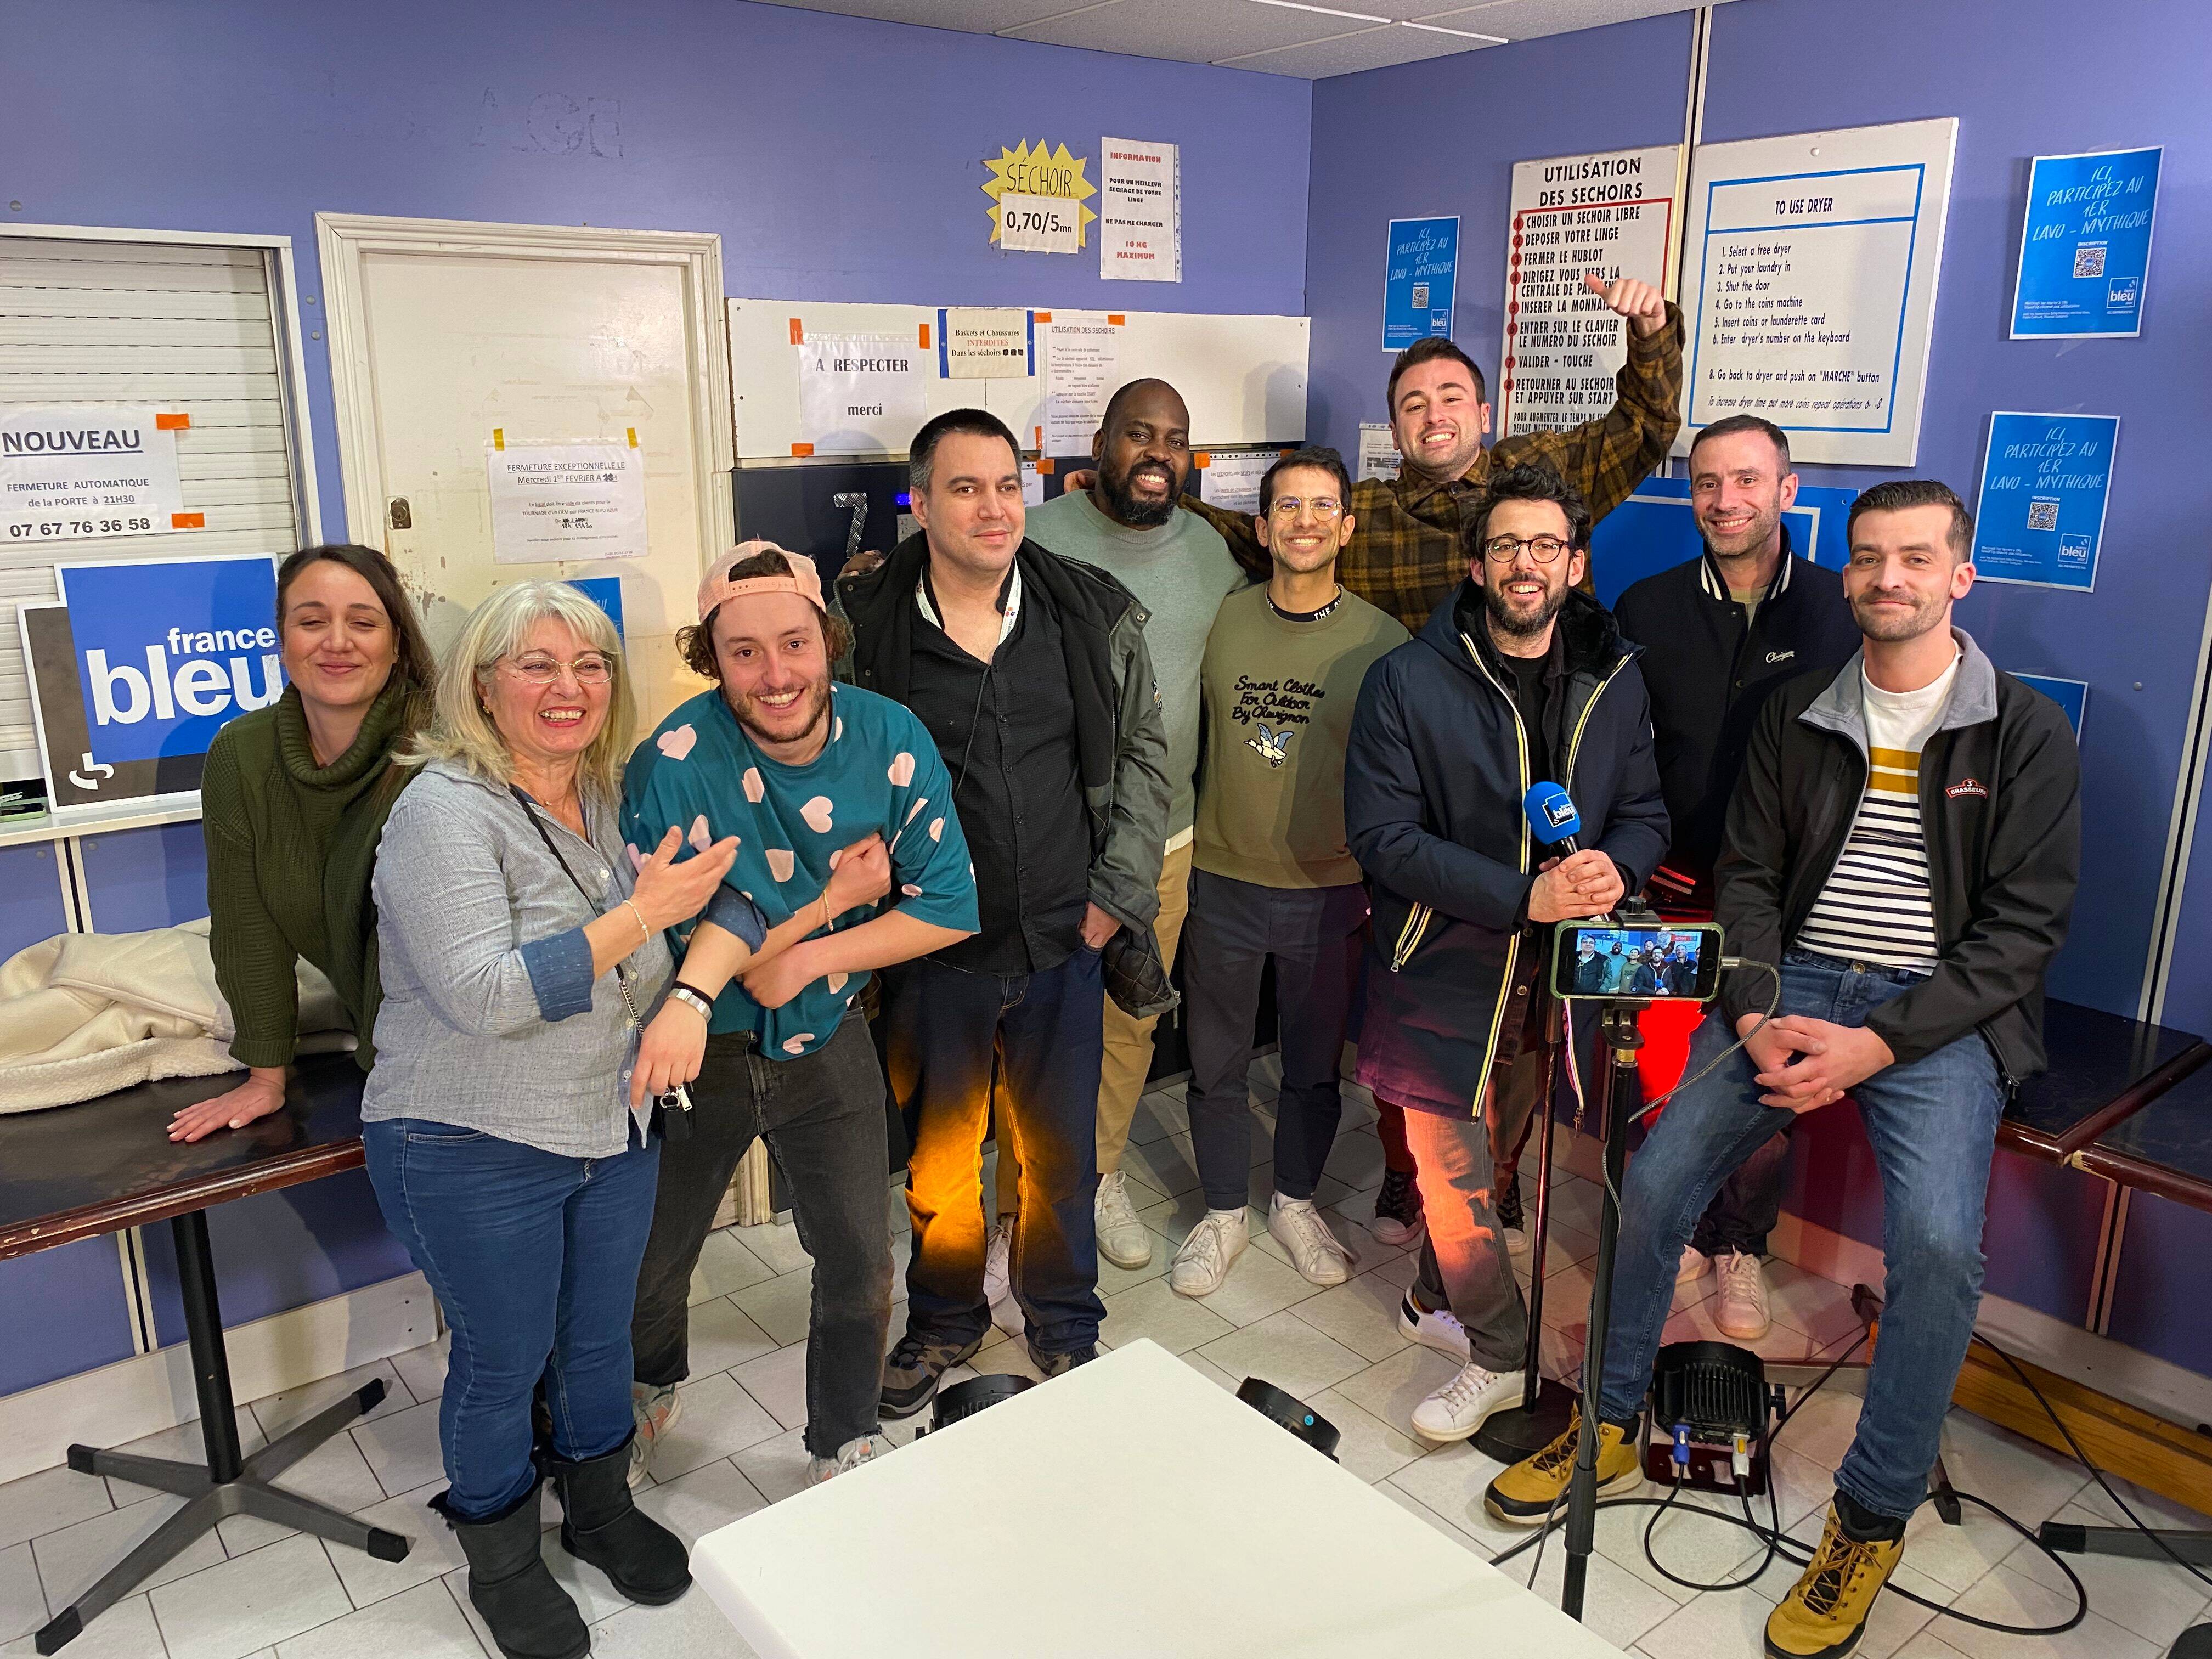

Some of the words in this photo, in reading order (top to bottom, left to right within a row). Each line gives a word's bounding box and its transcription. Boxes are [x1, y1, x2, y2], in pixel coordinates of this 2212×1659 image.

[1110, 152, 1161, 163] INFORMATION
[1007, 157, 1073, 196] SÉCHOIR
[1545, 157, 1641, 183] UTILISATION
[2091, 166, 2112, 184] ICI,
[1540, 190, 1564, 206] DES
[1572, 182, 1643, 204] SECHOIRS
[2047, 181, 2123, 206] PARTICIPEZ
[2126, 176, 2143, 193] AU
[1776, 201, 1785, 215] TO
[1790, 199, 1804, 213] USE
[1808, 198, 1833, 212] DRYER
[2083, 200, 2109, 217] 1ER
[1527, 214, 1557, 229] CHOISIR
[1562, 212, 1572, 225] UN
[1577, 209, 1611, 224] SECHOIR
[1616, 206, 1640, 221] LIBRE
[2033, 224, 2066, 241] LAVO
[2081, 209, 2150, 234] MYTHIQUE
[1526, 232, 1559, 246] DEPOSER
[1565, 229, 1590, 243] VOTRE
[1595, 227, 1618, 241] LINGE
[1525, 251, 1554, 266] FERMER
[1560, 250, 1567, 263] LE
[1572, 248, 1603, 262] HUBLOT
[1729, 246, 1747, 257] Select
[1758, 244, 1770, 255] free
[1774, 242, 1791, 257] dryer
[1523, 269, 1554, 284] DIRIGEZ
[1560, 269, 1579, 281] VOUS
[1610, 267, 1619, 279] LA
[1719, 264, 1724, 274] 2.
[1727, 263, 1737, 274] Put
[1740, 264, 1754, 276] your
[1757, 261, 1782, 275] laundry
[1785, 261, 1791, 272] in
[1717, 282, 1722, 292] 3.
[1726, 281, 1739, 292] Shut
[1742, 280, 1752, 291] the
[1756, 280, 1770, 290] door
[2110, 290, 2134, 302] bleu
[1432, 318, 1446, 326] bleu
[1520, 321, 1550, 334] ENTRER
[1553, 321, 1567, 333] SUR
[1572, 320, 1581, 332] LE
[1585, 319, 1618, 332] CLAVIER
[1714, 319, 1719, 328] 5.
[1723, 317, 1740, 327] Insert
[1743, 317, 1757, 327] coins
[1771, 315, 1807, 326] launderette
[1811, 313, 1825, 325] card
[1519, 336, 1526, 348] LE
[1531, 335, 1564, 347] NUMERO
[1567, 335, 1578, 347] DU
[1582, 334, 1616, 346] SECHOIR
[1713, 336, 1718, 345] 6.
[1721, 334, 1736, 344] Enter
[1741, 333, 1763, 346] dryer's
[1766, 332, 1790, 343] number
[1793, 334, 1801, 343] on
[1804, 332, 1814, 342] the
[1818, 331, 1850, 345] keyboard
[816, 359, 824, 372] A
[834, 359, 909, 373] RESPECTER
[1519, 356, 1549, 368] VALIDER
[1563, 355, 1593, 367] TOUCHE
[1516, 379, 1560, 390] RETOURNER
[1566, 378, 1576, 390] AU
[1581, 377, 1614, 390] SECHOIR
[1709, 369, 1714, 379] 8.
[1718, 369, 1725, 379] Go
[1729, 369, 1742, 380] back
[1746, 370, 1752, 380] to
[1756, 370, 1772, 382] dryer
[1776, 370, 1787, 381] and
[1790, 370, 1804, 383] push
[1808, 373, 1816, 381] on
[1820, 371, 1854, 382] "MARCHE"
[1857, 371, 1879, 382] button
[1515, 392, 1523, 404] ET
[1527, 392, 1564, 404] APPUYER
[1568, 392, 1583, 404] SUR
[1588, 392, 1613, 404] START
[848, 404, 883, 416] merci
[1, 430, 140, 453] NOUVEAU
[2046, 427, 2066, 443] ICI,
[2005, 443, 2075, 459] PARTICIPEZ
[2079, 442, 2098, 456] AU
[2038, 459, 2062, 473] 1ER
[7, 481, 69, 492] FERMETURE
[74, 478, 149, 489] AUTOMATIQUE
[1990, 476, 2021, 489] LAVO
[2035, 474, 2104, 489] MYTHIQUE
[28, 499, 40, 507] de
[43, 498, 52, 506] la
[55, 496, 87, 505] PORTE
[104, 494, 134, 504] 21H30
[9, 524, 32, 537] 07
[40, 523, 63, 535] 67
[70, 521, 93, 534] 76
[100, 519, 122, 532] 36
[128, 518, 151, 530] 58
[834, 493, 867, 558] 7
[2061, 545, 2086, 557] bleu
[167, 628, 275, 654] france
[86, 645, 284, 726] bleu
[1234, 675, 1278, 691] Smart
[1283, 679, 1325, 698] Clothes
[1240, 692, 1260, 705] For
[1263, 693, 1310, 710] Outdoor
